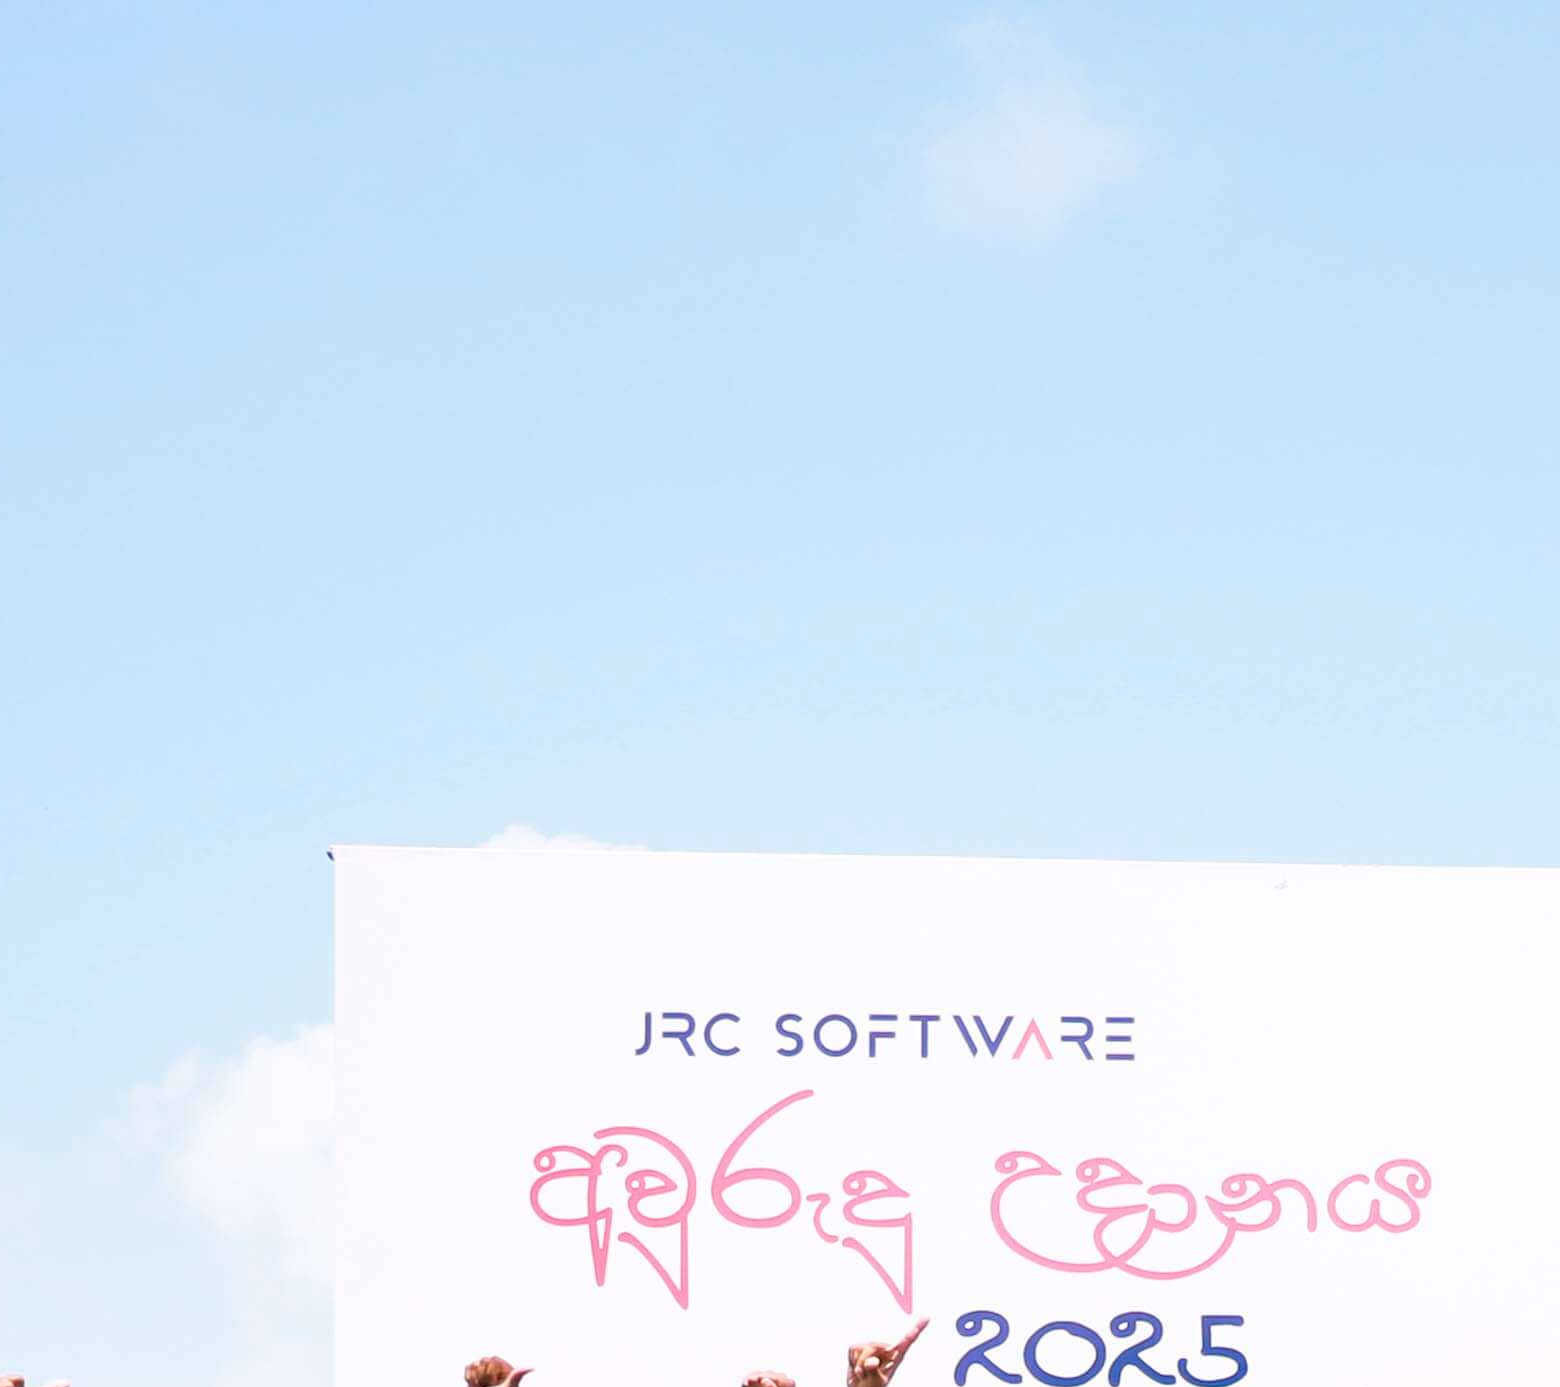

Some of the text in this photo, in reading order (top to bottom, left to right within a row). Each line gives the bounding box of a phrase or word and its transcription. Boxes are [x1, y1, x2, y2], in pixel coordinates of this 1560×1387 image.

[634, 1011, 1137, 1062] JRC SOFTWARE
[528, 1087, 915, 1317] අවුරුදු
